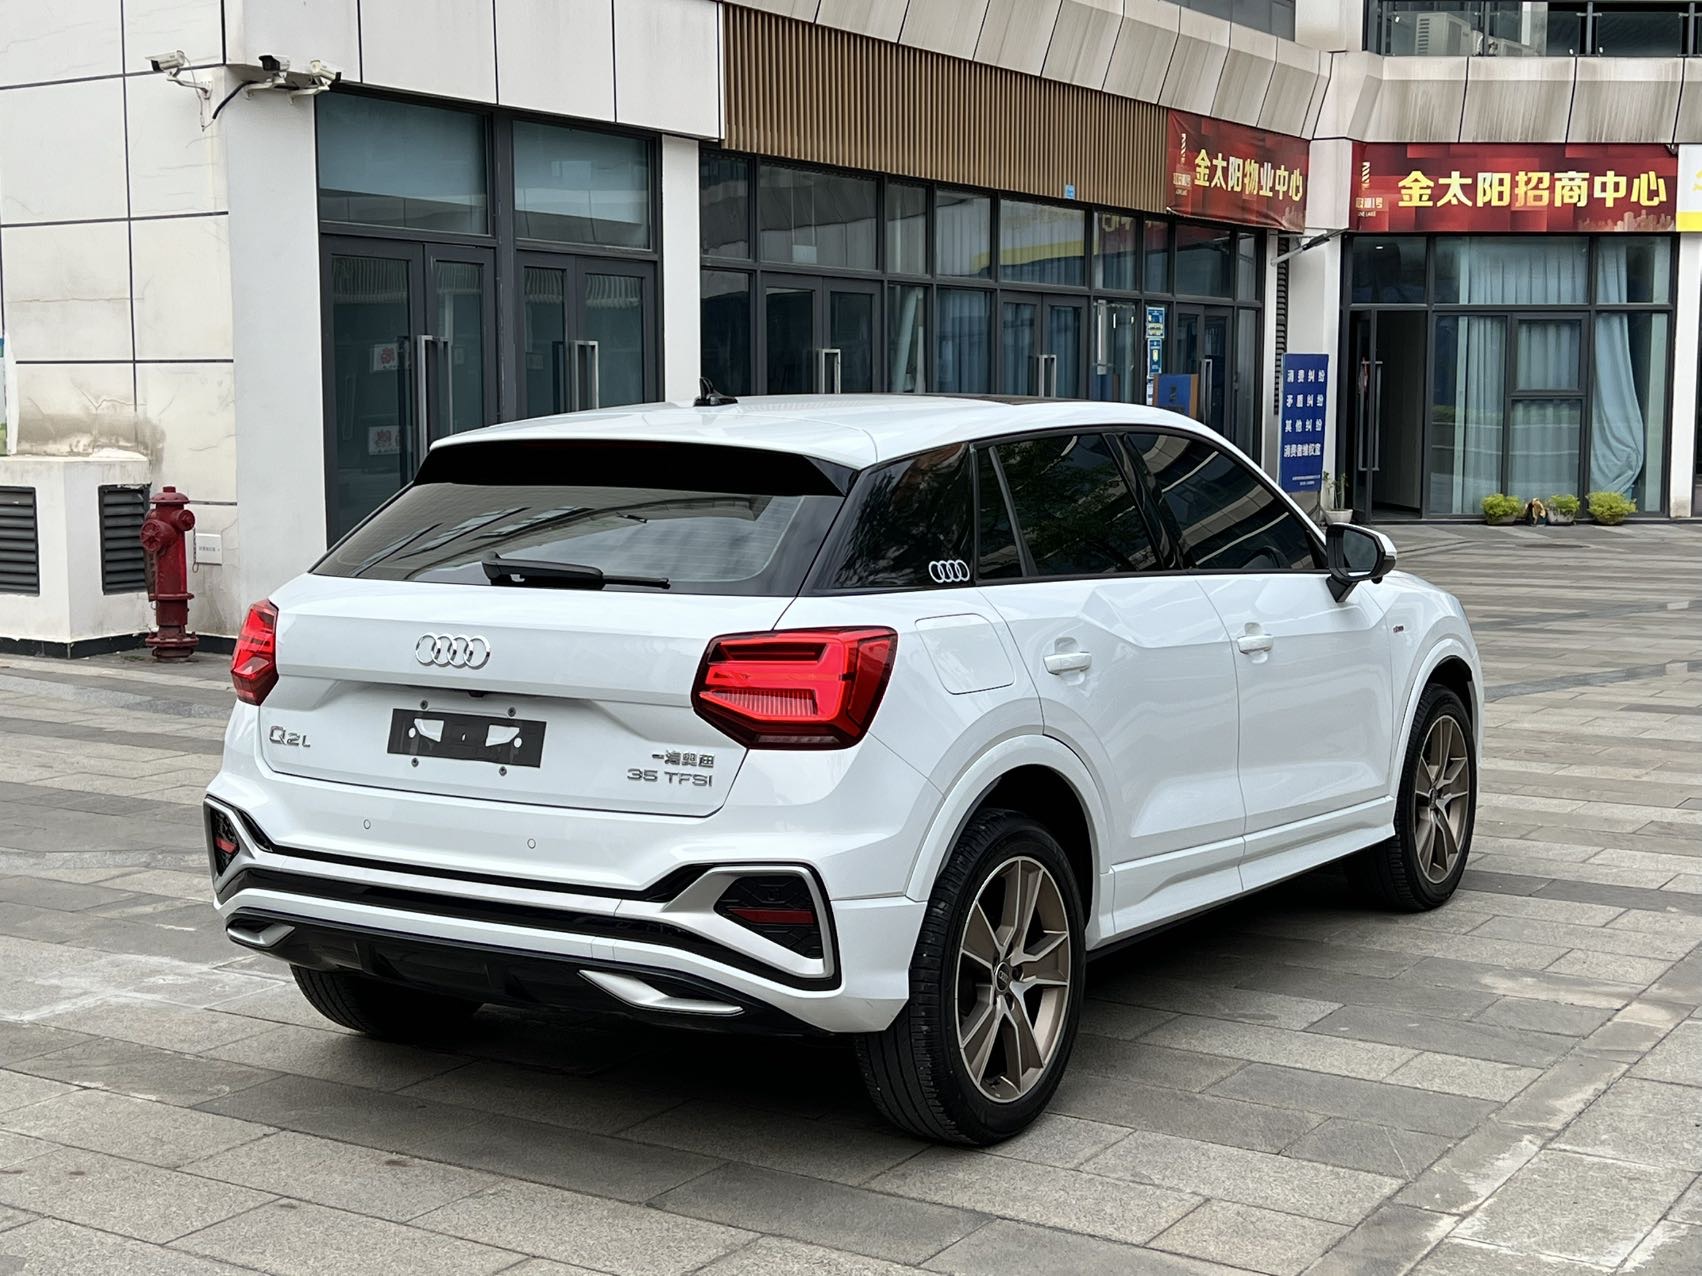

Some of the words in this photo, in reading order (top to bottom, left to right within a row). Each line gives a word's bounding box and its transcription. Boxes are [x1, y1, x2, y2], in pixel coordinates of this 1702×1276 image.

[1194, 149, 1303, 201] 金太阳物业中心
[1398, 170, 1667, 207] 金太阳招商中心
[1287, 369, 1325, 382] 消费纠纷
[269, 725, 311, 748] Q2L
[627, 768, 658, 782] 35
[664, 771, 712, 787] TFSI
